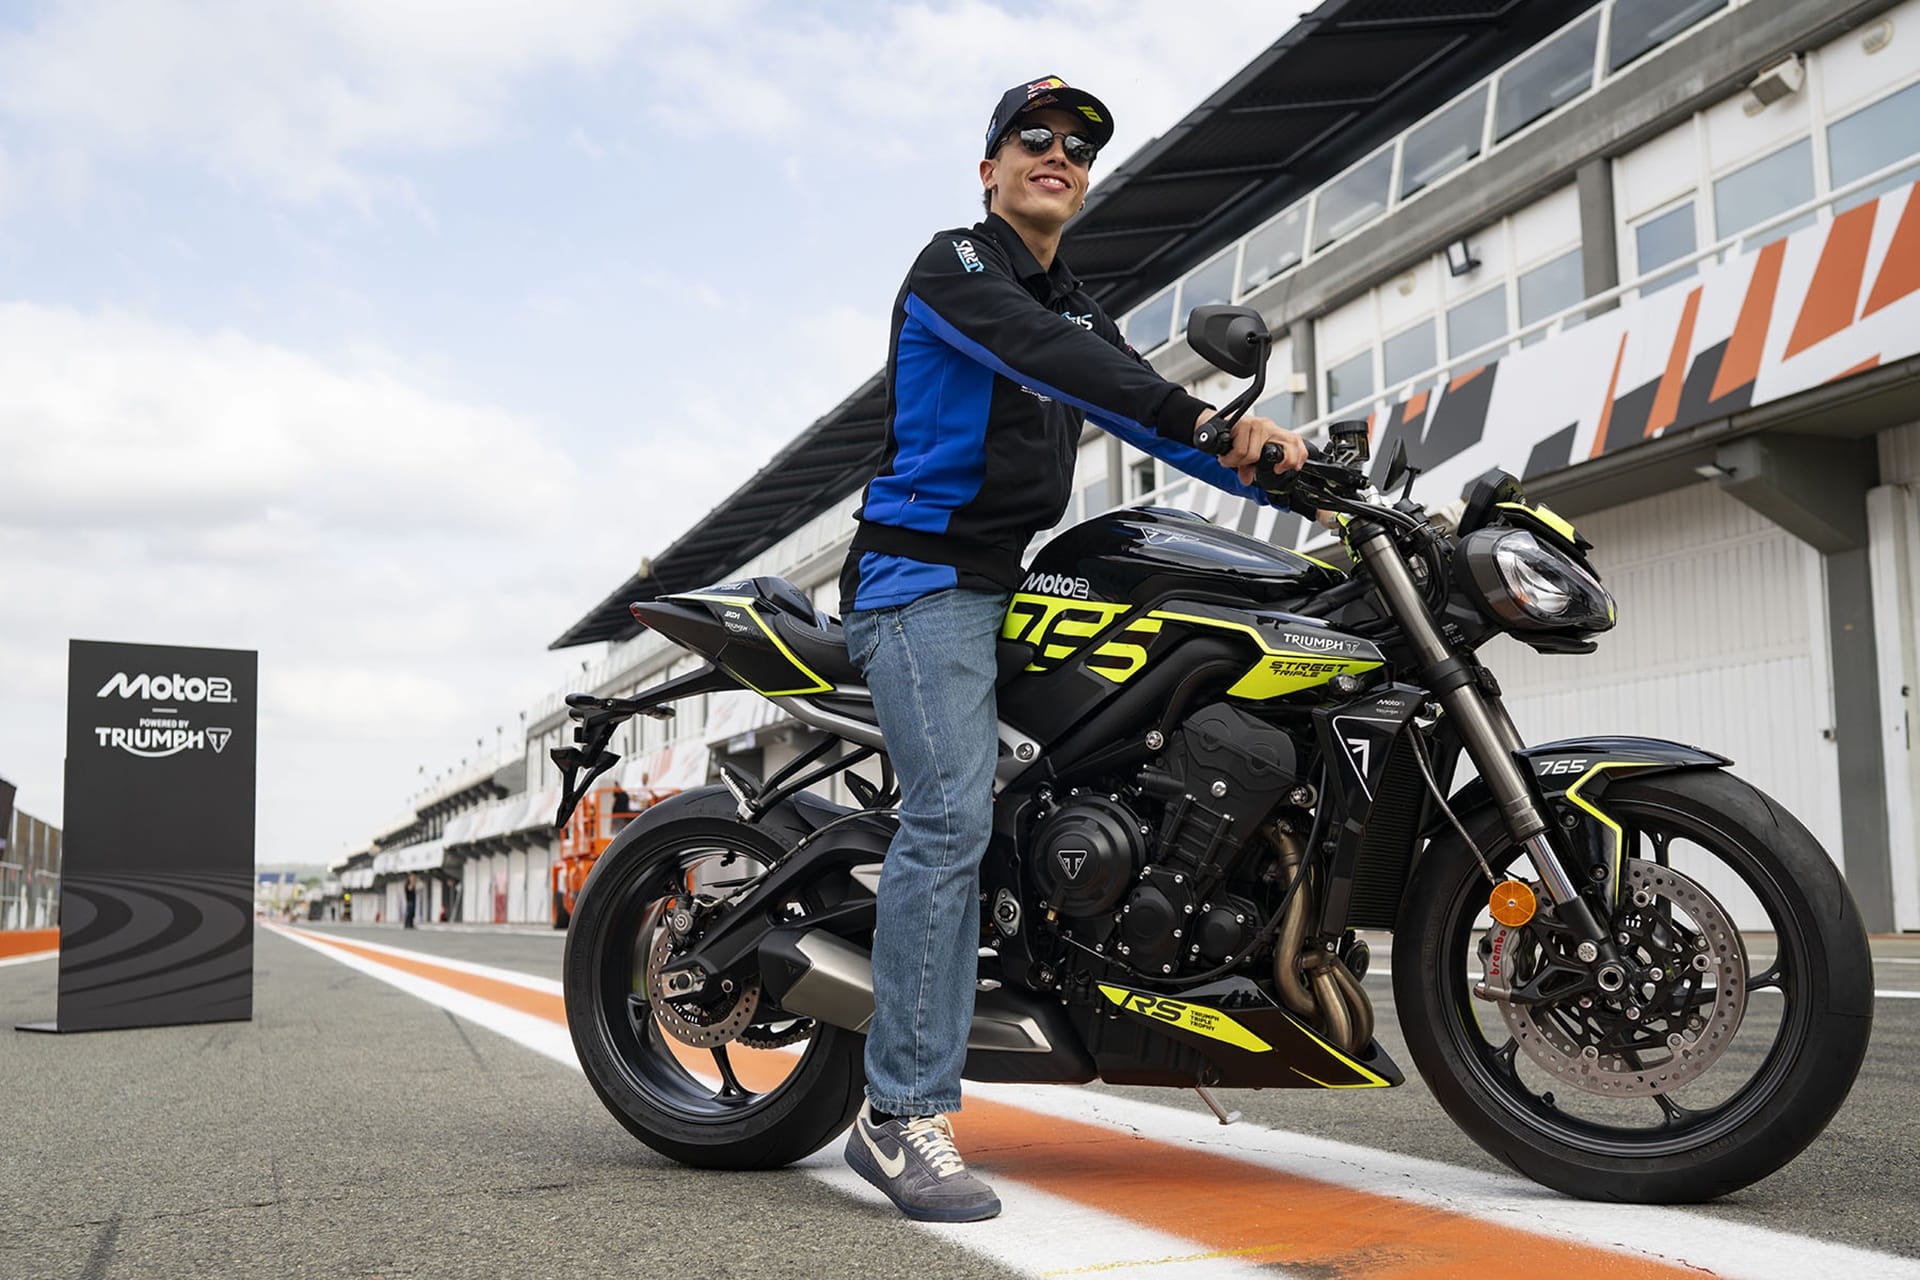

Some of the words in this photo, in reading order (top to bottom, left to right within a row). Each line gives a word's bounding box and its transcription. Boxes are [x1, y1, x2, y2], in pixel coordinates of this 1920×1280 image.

[1020, 572, 1089, 599] Moto2
[1284, 633, 1343, 651] TRIUMPH
[1269, 661, 1350, 673] STREET
[1273, 669, 1320, 678] TRIPLE
[97, 672, 233, 703] Moto2
[140, 718, 177, 728] POWERED
[178, 719, 190, 729] BY
[95, 727, 205, 757] TRIUMPH
[1539, 759, 1587, 776] 765
[1489, 930, 1507, 976] brembo
[1121, 991, 1187, 1021] RS
[1190, 1016, 1212, 1025] TRIPLE
[1190, 1021, 1216, 1032] TROPHY
